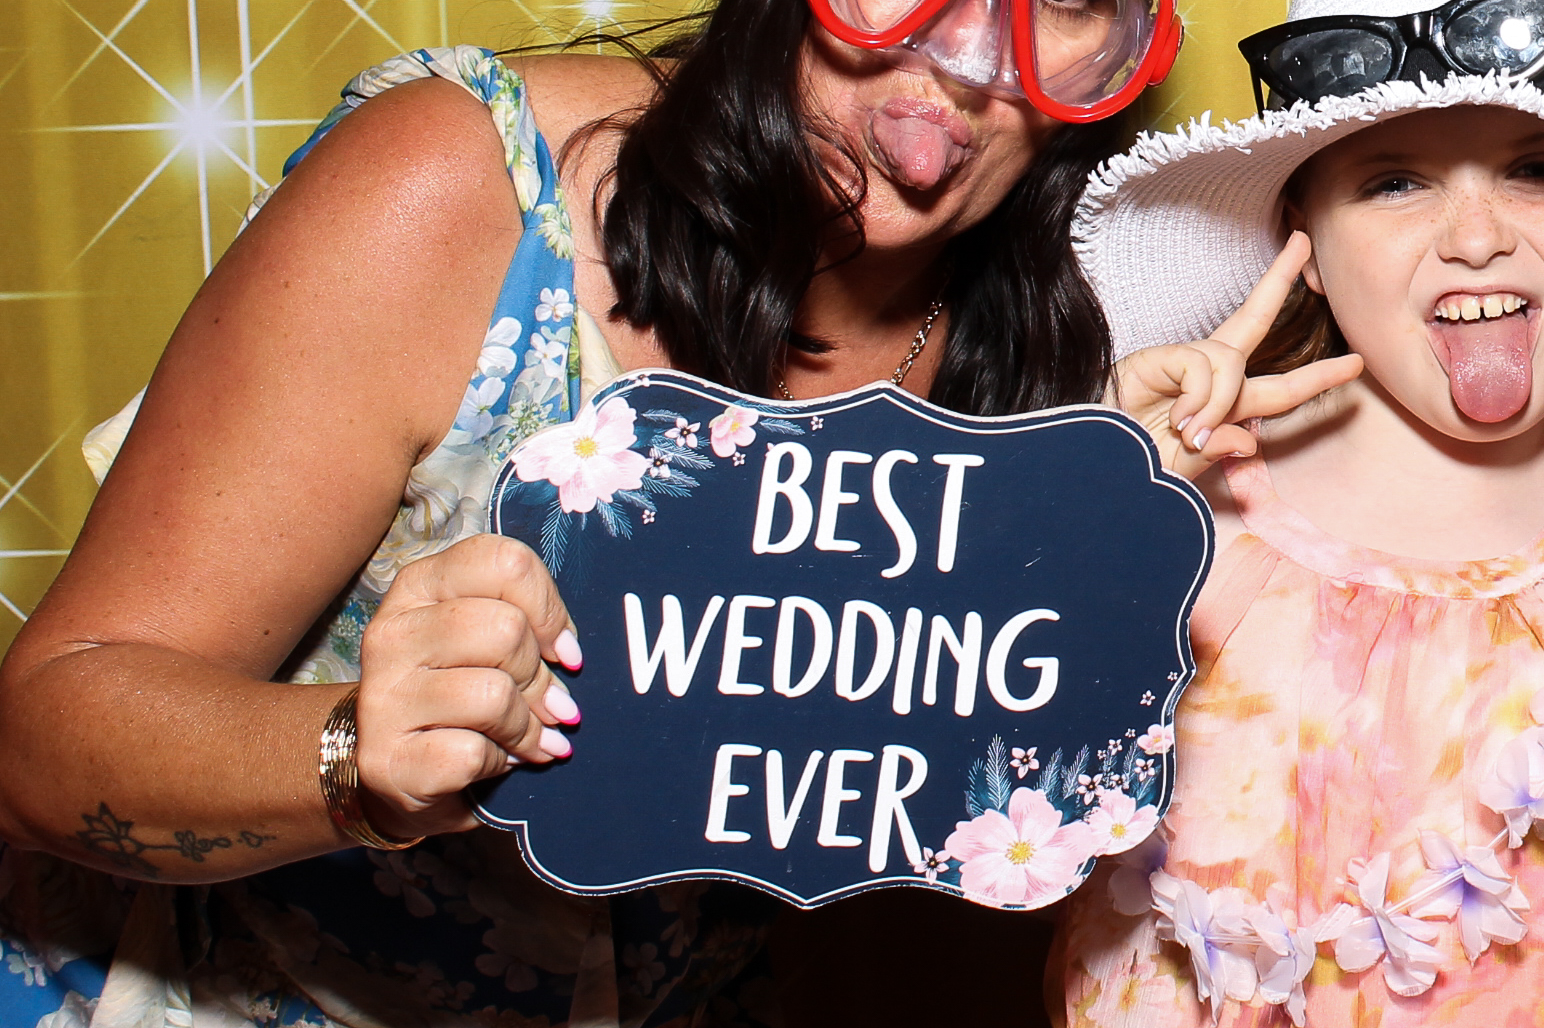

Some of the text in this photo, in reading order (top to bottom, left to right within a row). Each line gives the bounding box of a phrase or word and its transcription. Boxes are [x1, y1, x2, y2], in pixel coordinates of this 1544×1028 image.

[752, 441, 985, 579] BEST
[623, 592, 1061, 717] WEDDING
[704, 743, 928, 873] EVER
